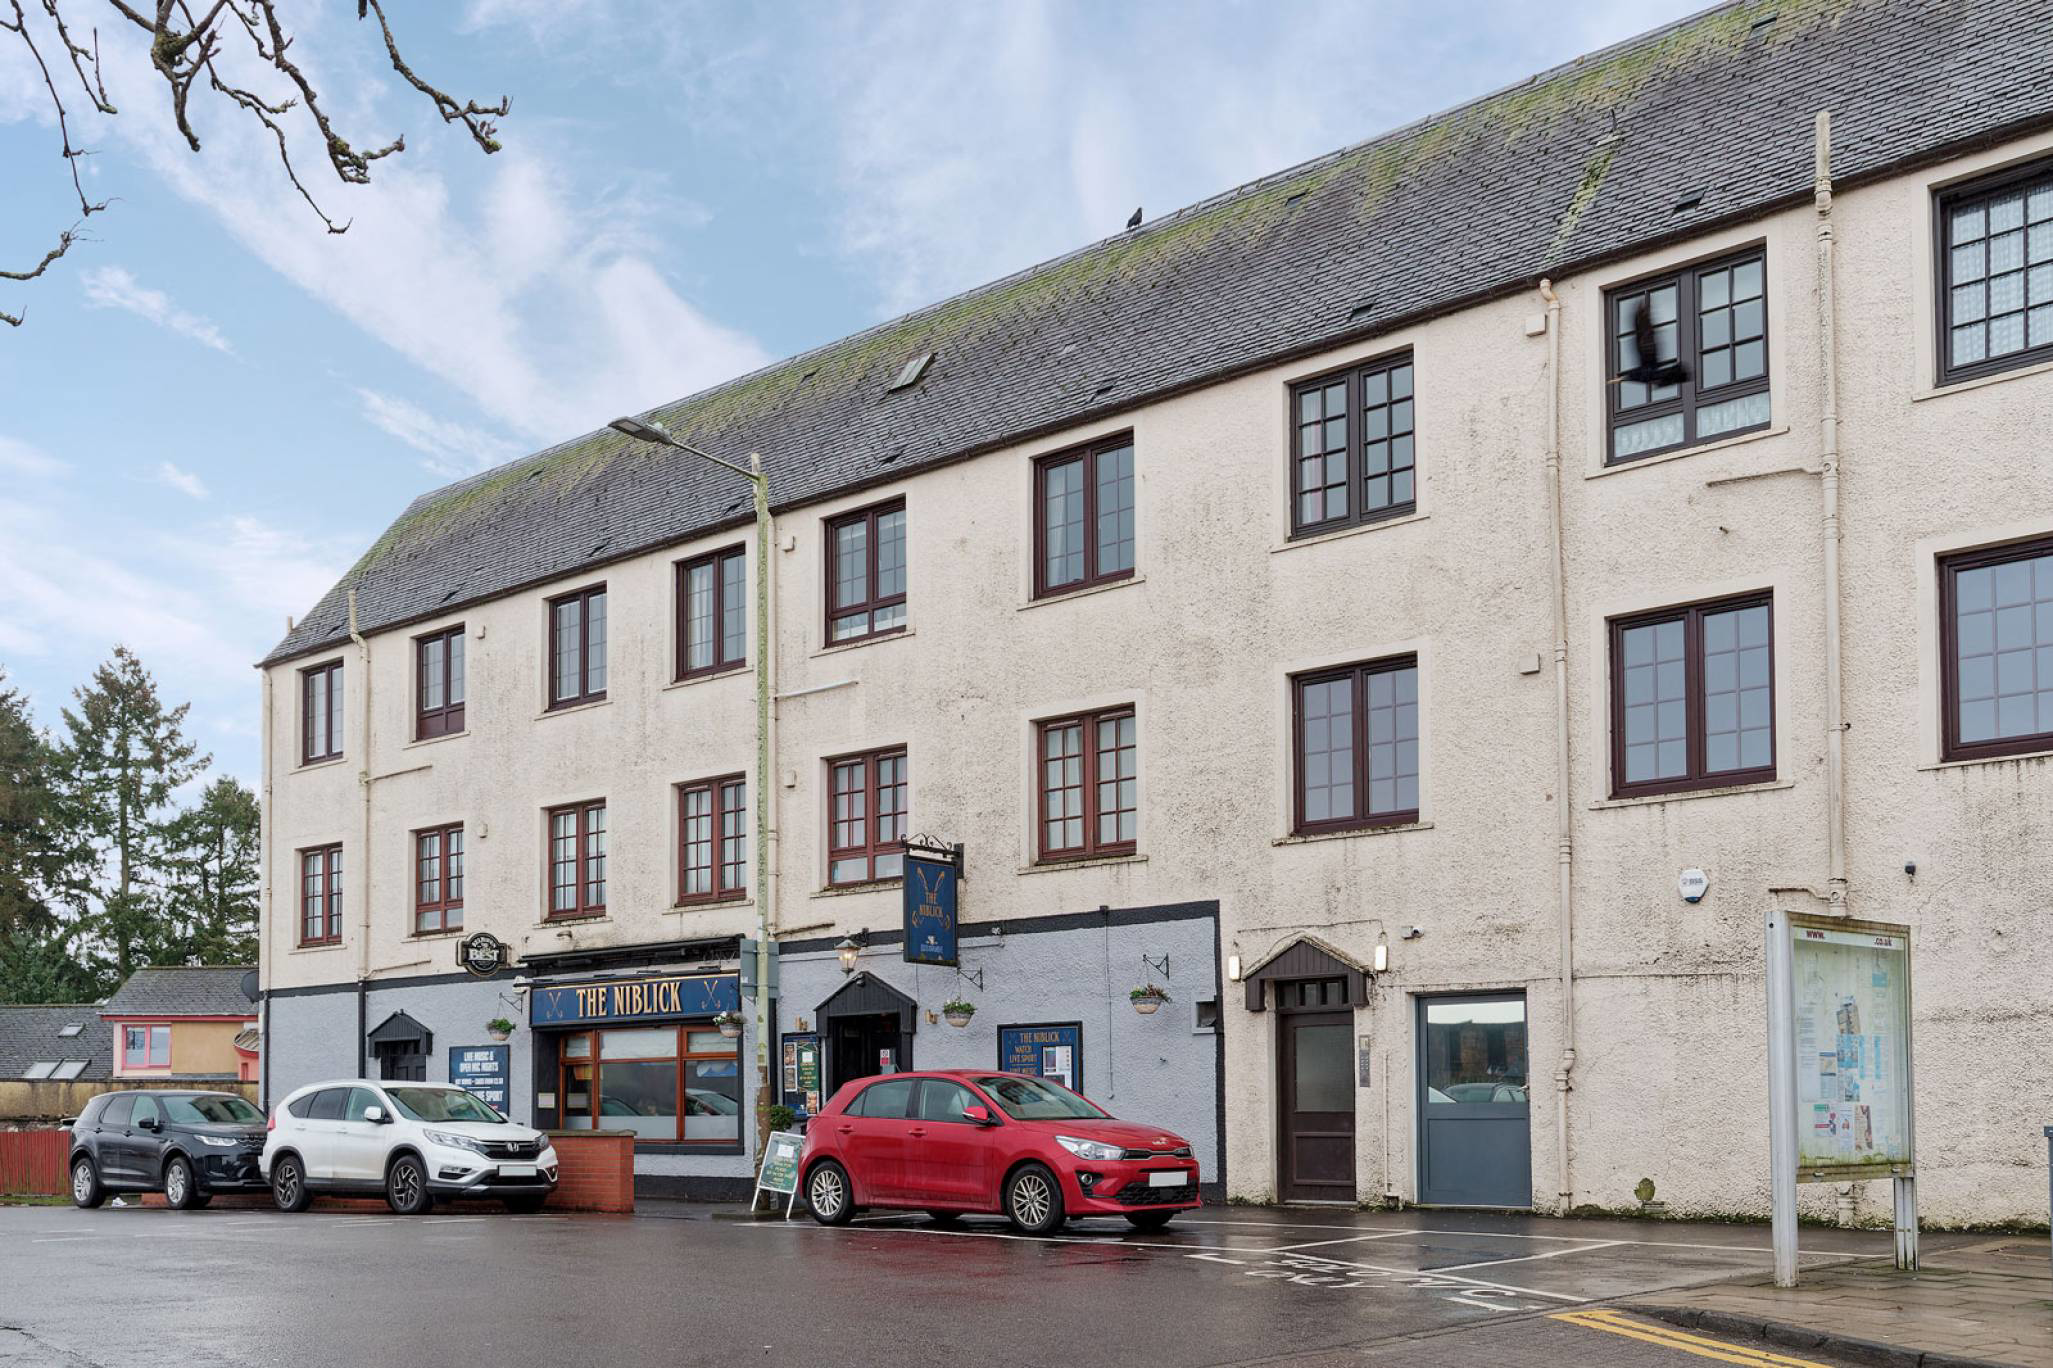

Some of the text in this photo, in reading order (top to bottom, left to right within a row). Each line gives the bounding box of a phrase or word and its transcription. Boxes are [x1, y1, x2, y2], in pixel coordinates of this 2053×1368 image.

[919, 904, 943, 918] NIBLICK
[468, 949, 499, 961] BEST
[576, 982, 682, 1018] THE NIBLICK
[1020, 1031, 1059, 1043] THE NIBLICK
